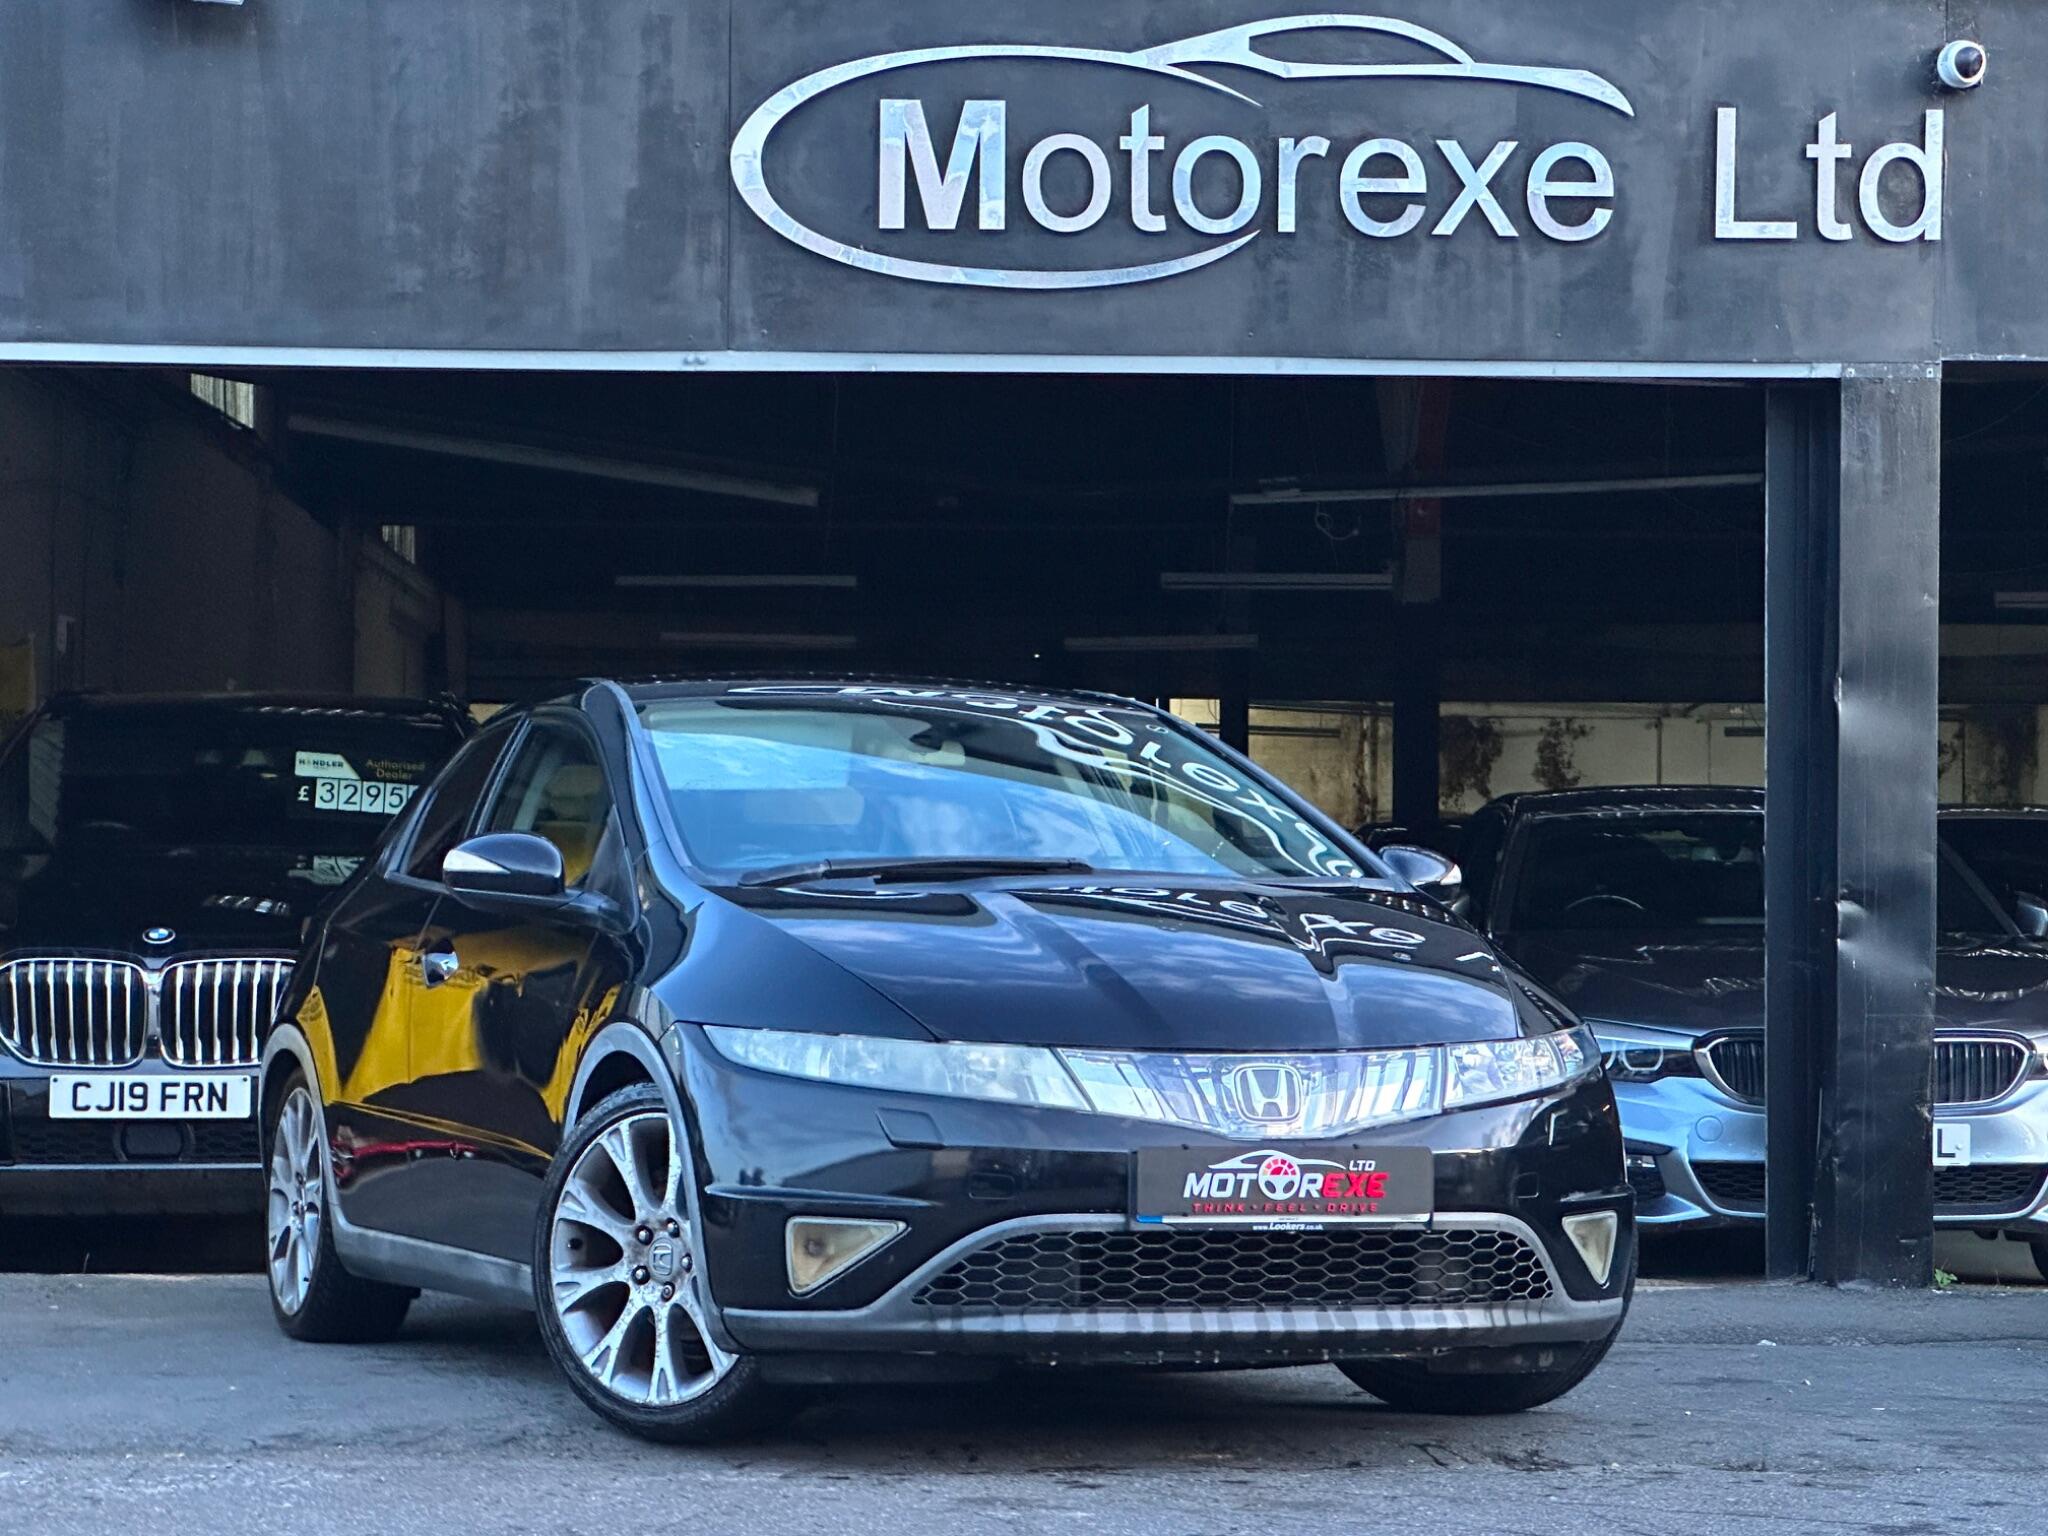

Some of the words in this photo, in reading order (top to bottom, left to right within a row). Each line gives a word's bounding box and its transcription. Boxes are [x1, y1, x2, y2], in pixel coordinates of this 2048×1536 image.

[878, 98, 1615, 242] Motorexe
[1714, 106, 1944, 243] Ltd
[376, 768, 413, 780] Dealer
[72, 1081, 148, 1112] CJ19
[160, 1082, 228, 1112] FRN
[1349, 1159, 1376, 1172] LTD
[1183, 1156, 1390, 1200] MOTOREXE
[1192, 1203, 1245, 1213] THINK
[1263, 1203, 1308, 1213] FEEL
[1327, 1203, 1379, 1213] DRIVE
